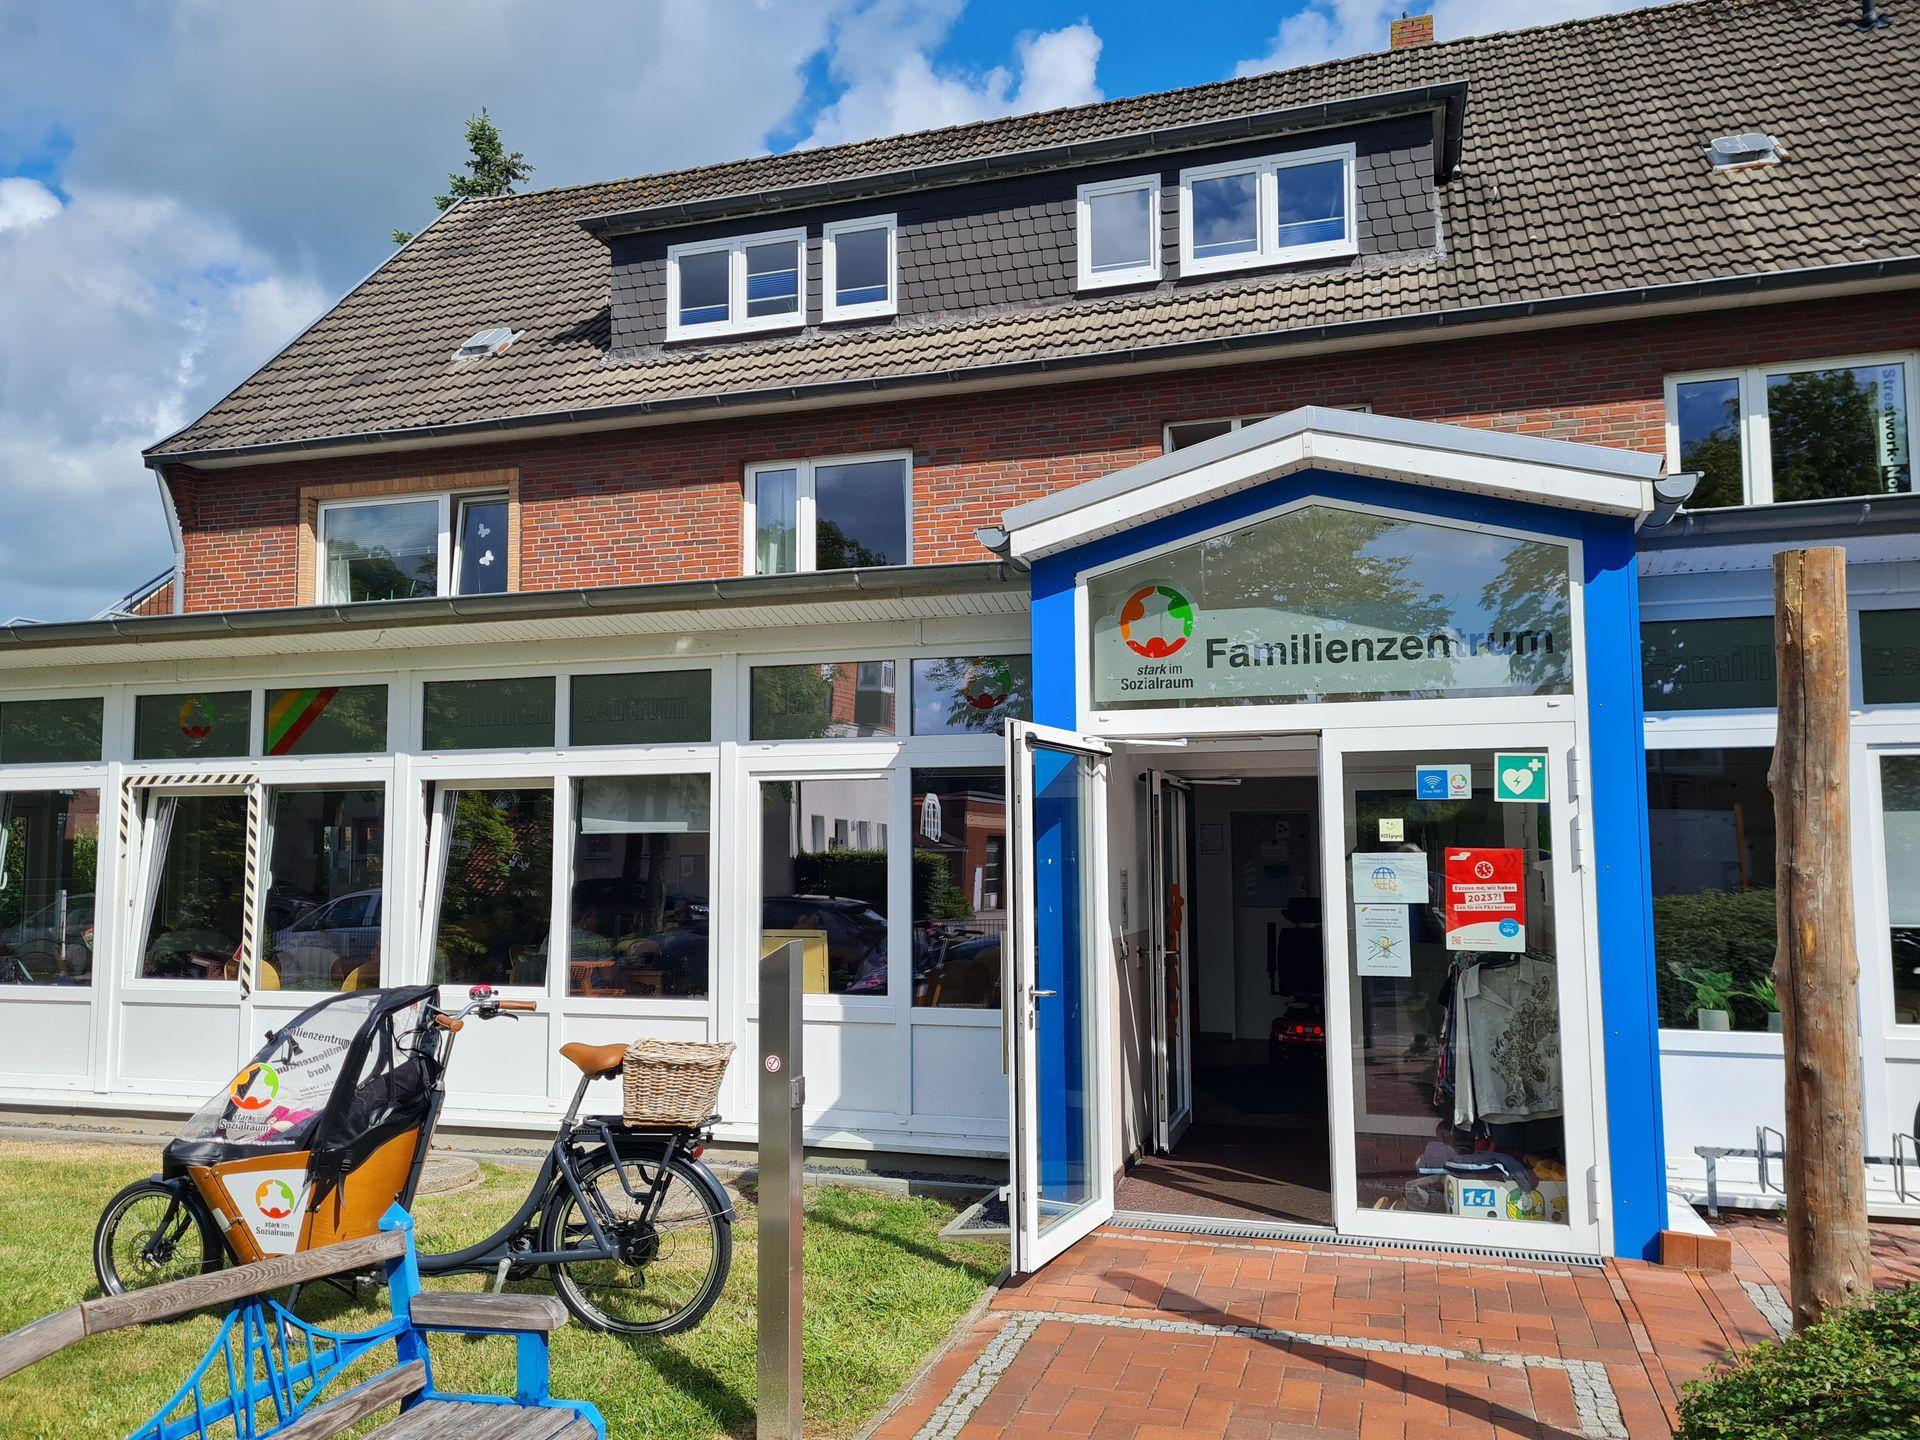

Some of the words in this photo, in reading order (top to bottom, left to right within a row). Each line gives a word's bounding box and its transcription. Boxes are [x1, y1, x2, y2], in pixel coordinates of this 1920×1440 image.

[1205, 625, 1555, 669] Familienzentrum
[1137, 663, 1167, 676] stark
[1168, 663, 1183, 675] im
[1121, 677, 1194, 690] Sozialraum
[1468, 893, 1502, 903] 2023?!
[218, 1119, 270, 1133] Sozialraum
[255, 1226, 295, 1238] Sozialraum
